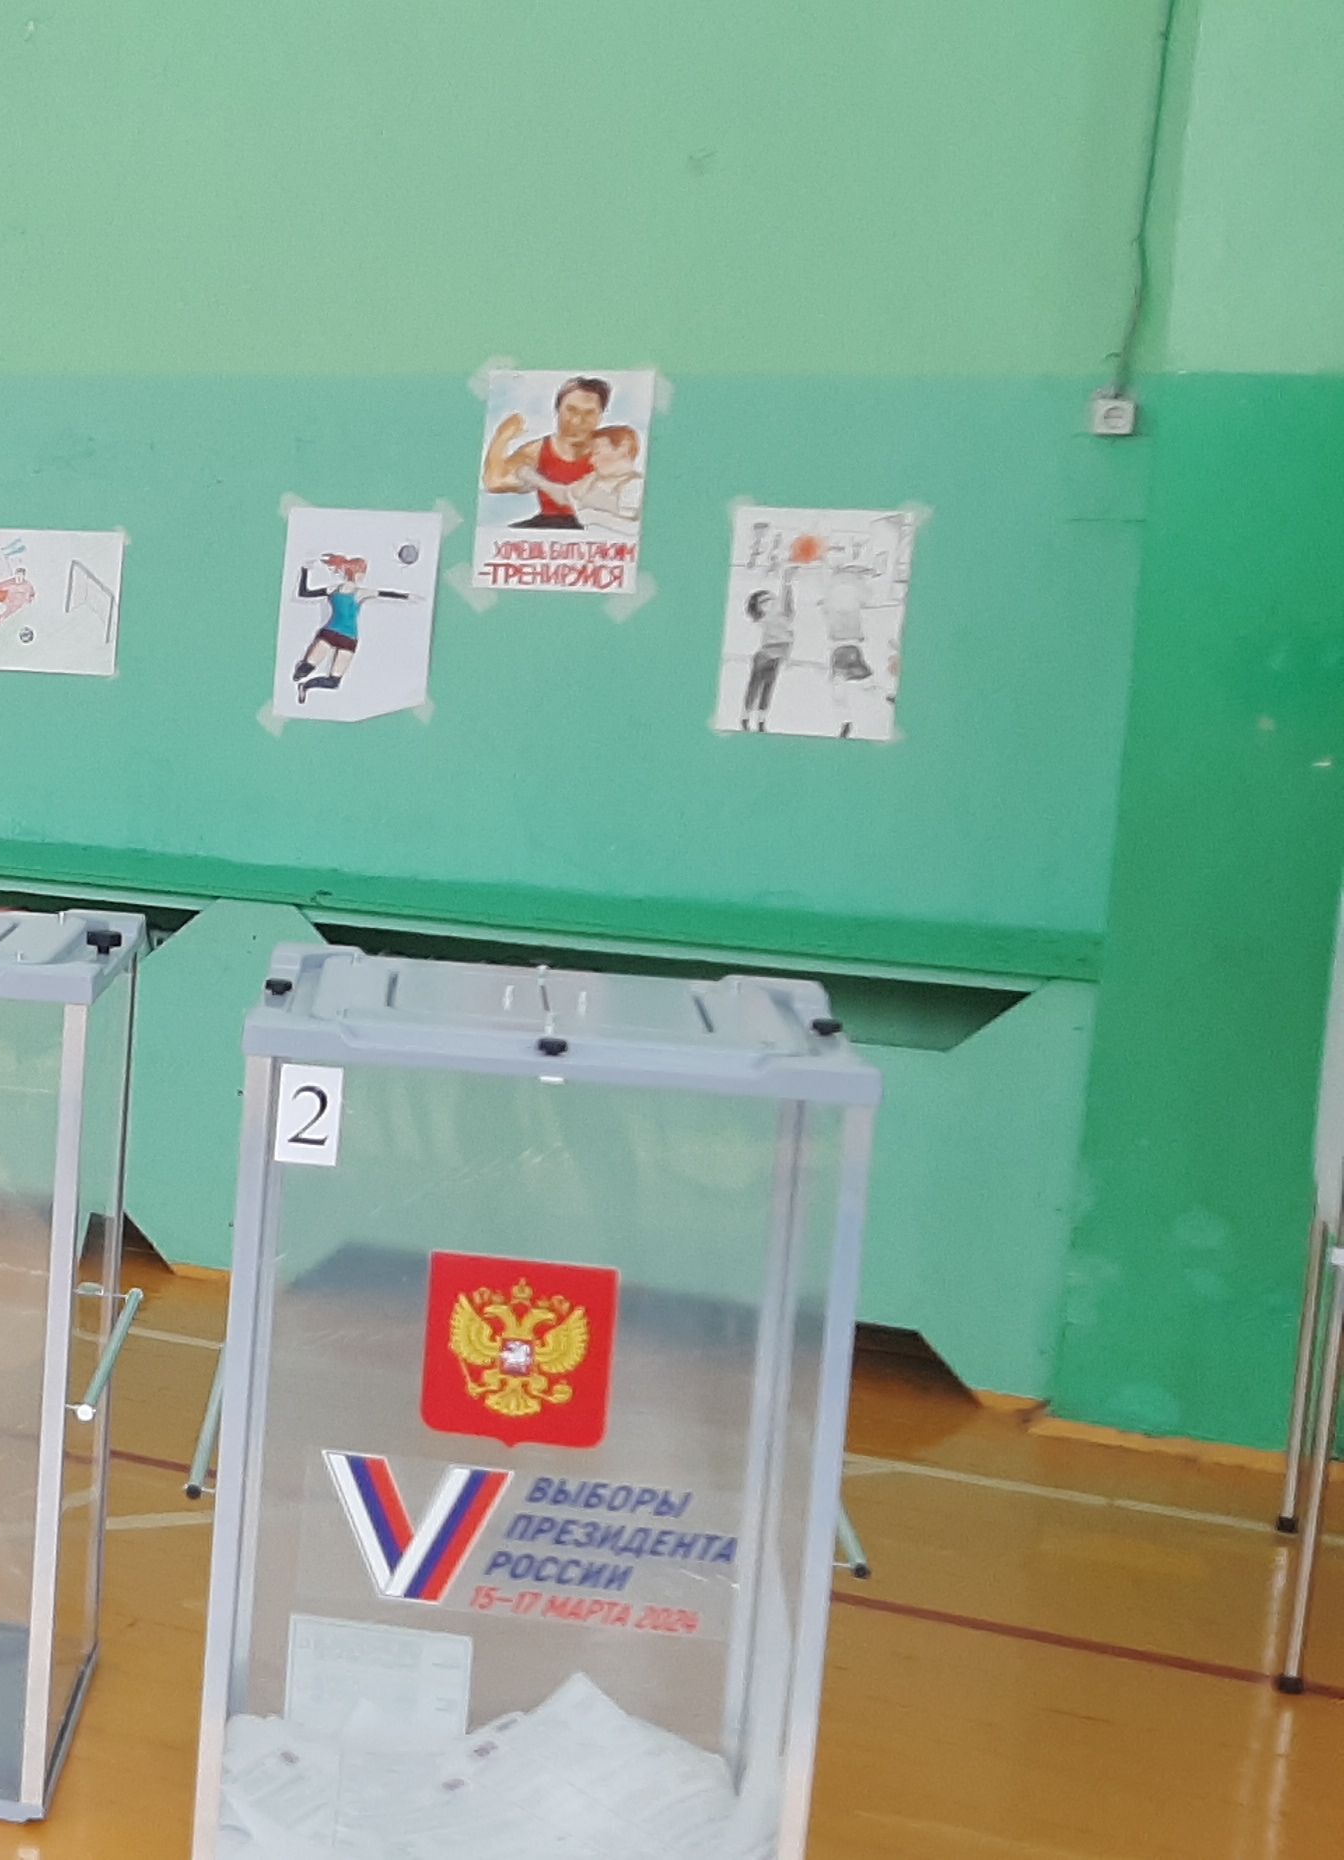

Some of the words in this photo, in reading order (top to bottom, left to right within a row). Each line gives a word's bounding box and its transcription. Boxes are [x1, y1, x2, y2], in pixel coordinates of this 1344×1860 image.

[287, 1084, 330, 1147] 2
[525, 1476, 693, 1518] ВЫБОРЫ
[505, 1513, 738, 1563] ПРЕЗИДЕНТА
[484, 1550, 635, 1591] РОССИИ
[543, 1595, 632, 1625] МАРТА
[635, 1605, 700, 1634] 2024
